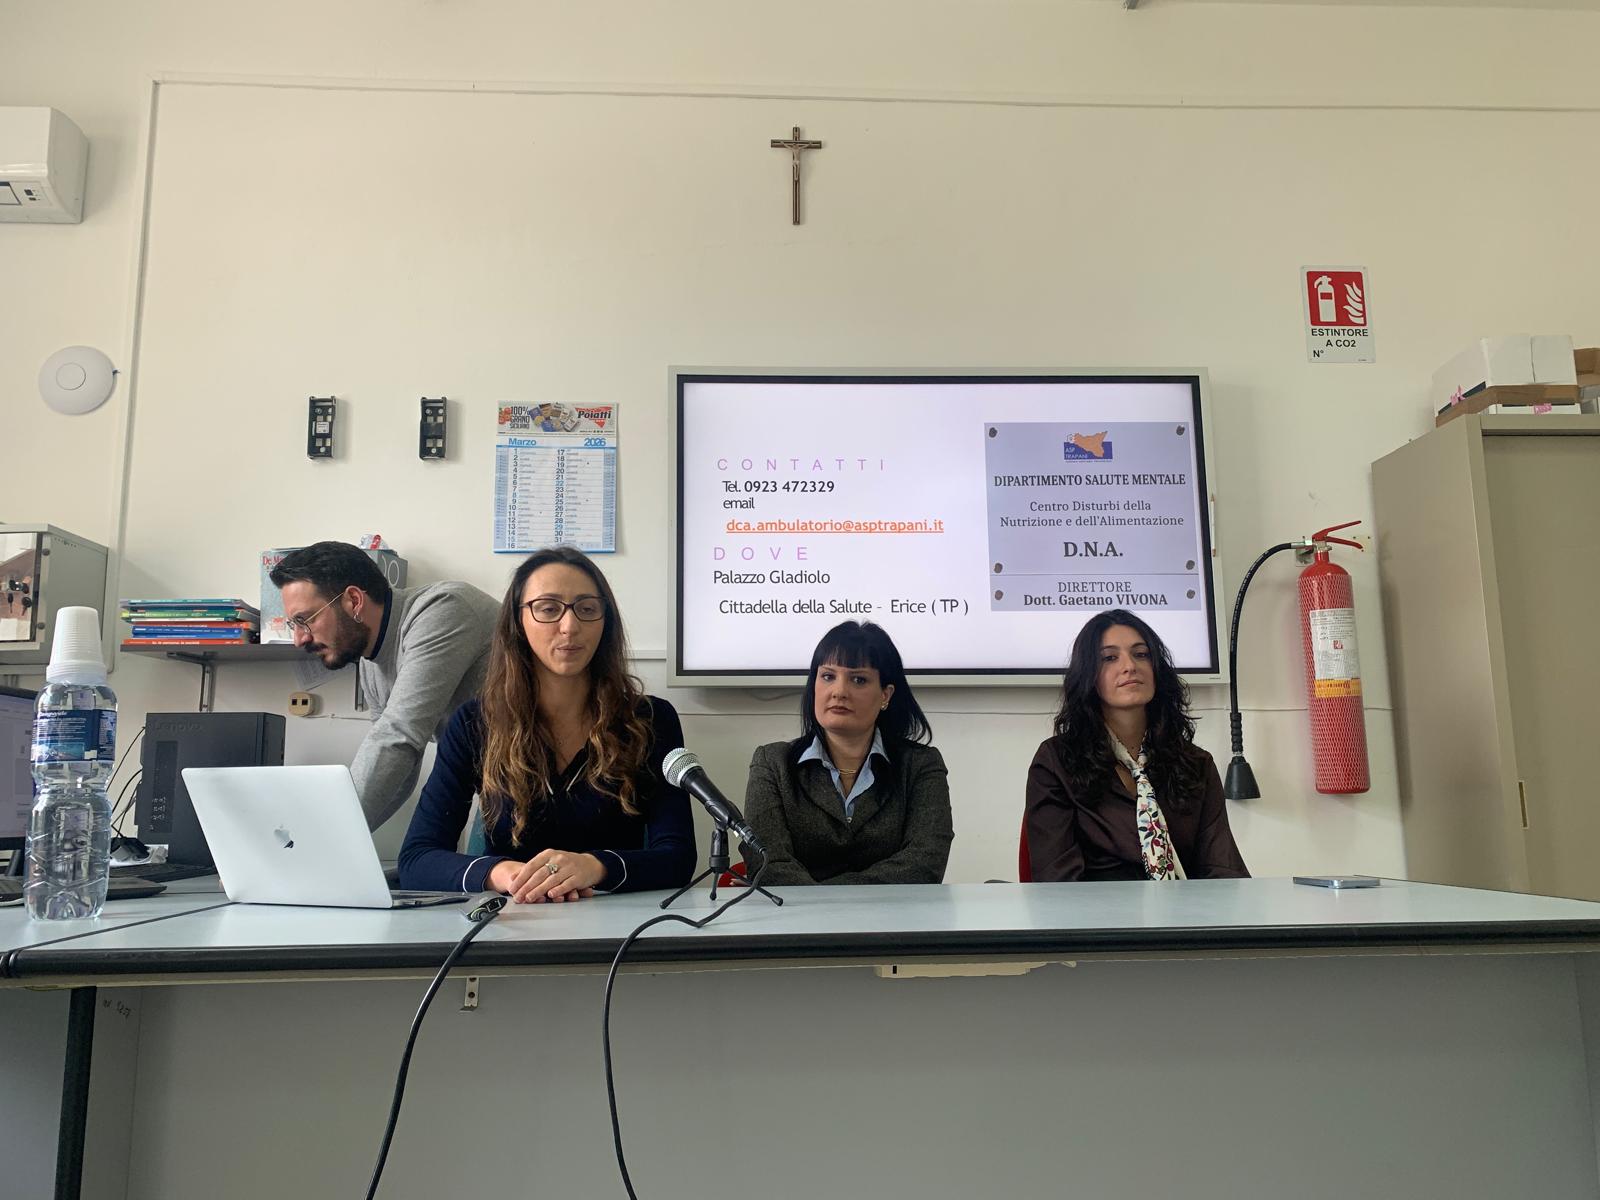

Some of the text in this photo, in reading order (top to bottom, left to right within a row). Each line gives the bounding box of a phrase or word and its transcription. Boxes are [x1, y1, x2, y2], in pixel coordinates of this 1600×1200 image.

[1311, 328, 1368, 336] ESTINTORE
[511, 406, 529, 415] 100%
[577, 410, 611, 419] Poiatti
[508, 437, 607, 447] Marzo 2026
[717, 459, 884, 471] CONTATTI
[722, 481, 835, 492] Tel. 0923 472329
[994, 474, 1186, 487] DIPARTIMENTO SALUTE MENTALE
[723, 497, 755, 509] email
[1030, 500, 1151, 511] Centro Disturbi della
[726, 519, 944, 533] dca.ambulatorio@asptrapani.it
[1000, 516, 1062, 527] Nutrizione
[1075, 515, 1184, 526] dell'Alimentazione
[714, 547, 808, 560] DOVE
[1063, 542, 1124, 557] D.N.A.
[714, 570, 831, 584] Palazzo Gladiolo
[1058, 581, 1132, 592] DIRETTORE
[1024, 594, 1168, 606] Dott. Gaetano VIVONA
[719, 600, 787, 614] Cittadella
[792, 600, 825, 614] della
[830, 600, 872, 614] Salute
[891, 600, 926, 613] Erice
